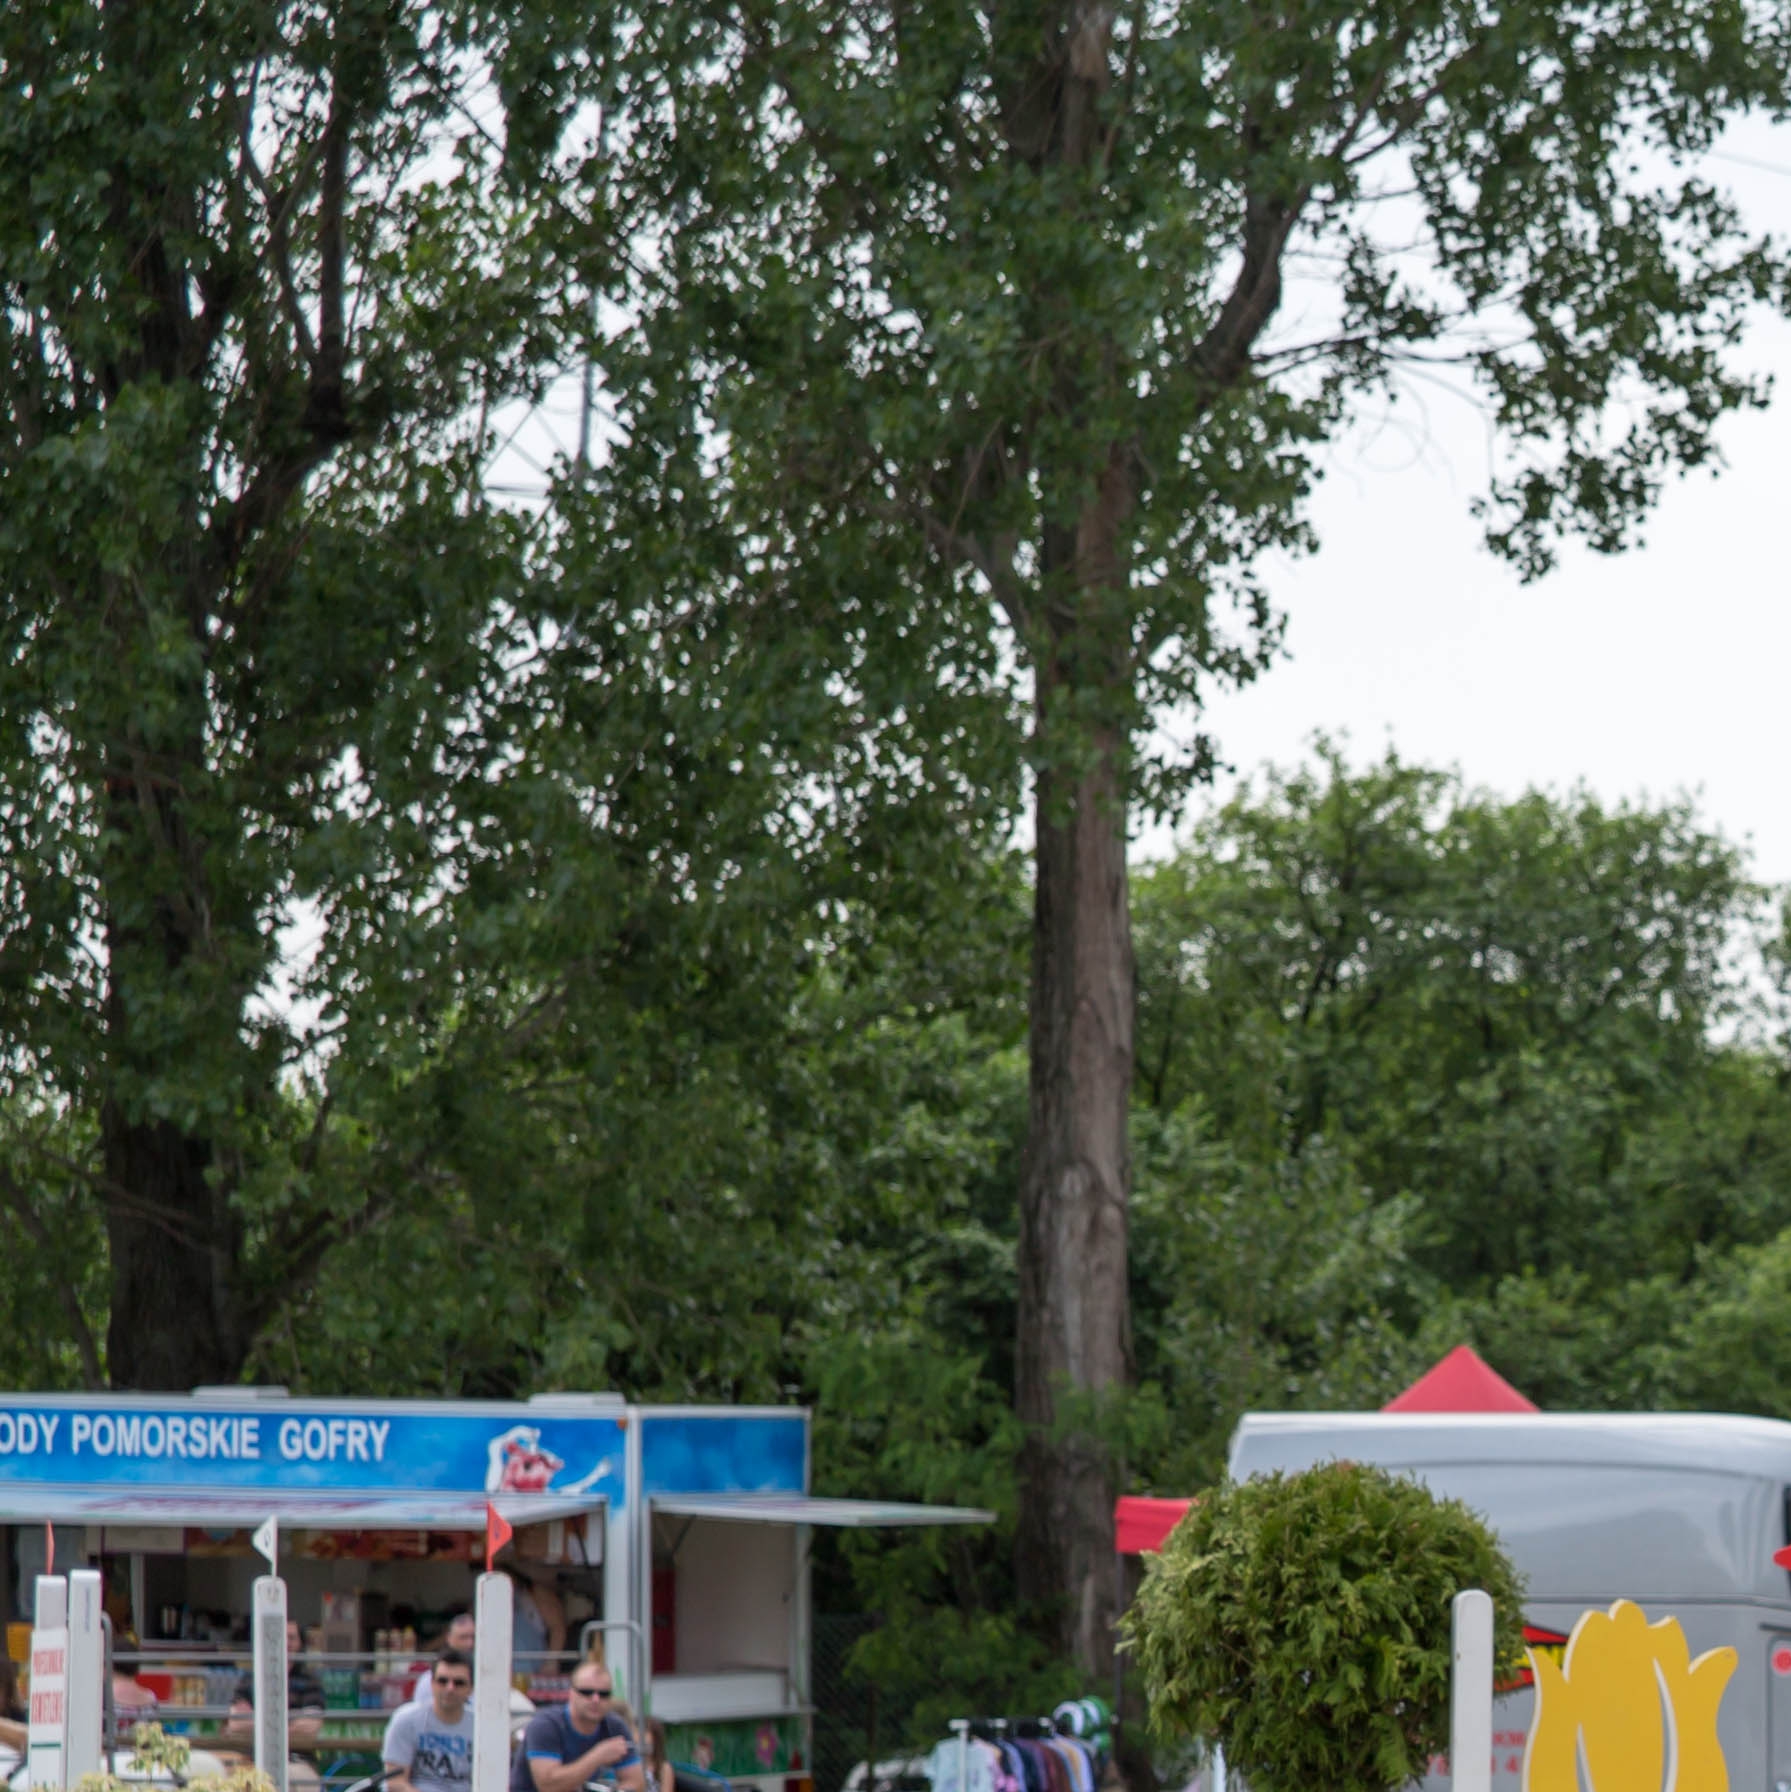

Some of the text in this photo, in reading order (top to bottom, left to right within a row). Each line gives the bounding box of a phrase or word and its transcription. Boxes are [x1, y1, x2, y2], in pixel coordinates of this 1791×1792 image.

[0, 1413, 391, 1462] ODY POMORSKIE GOFRY
